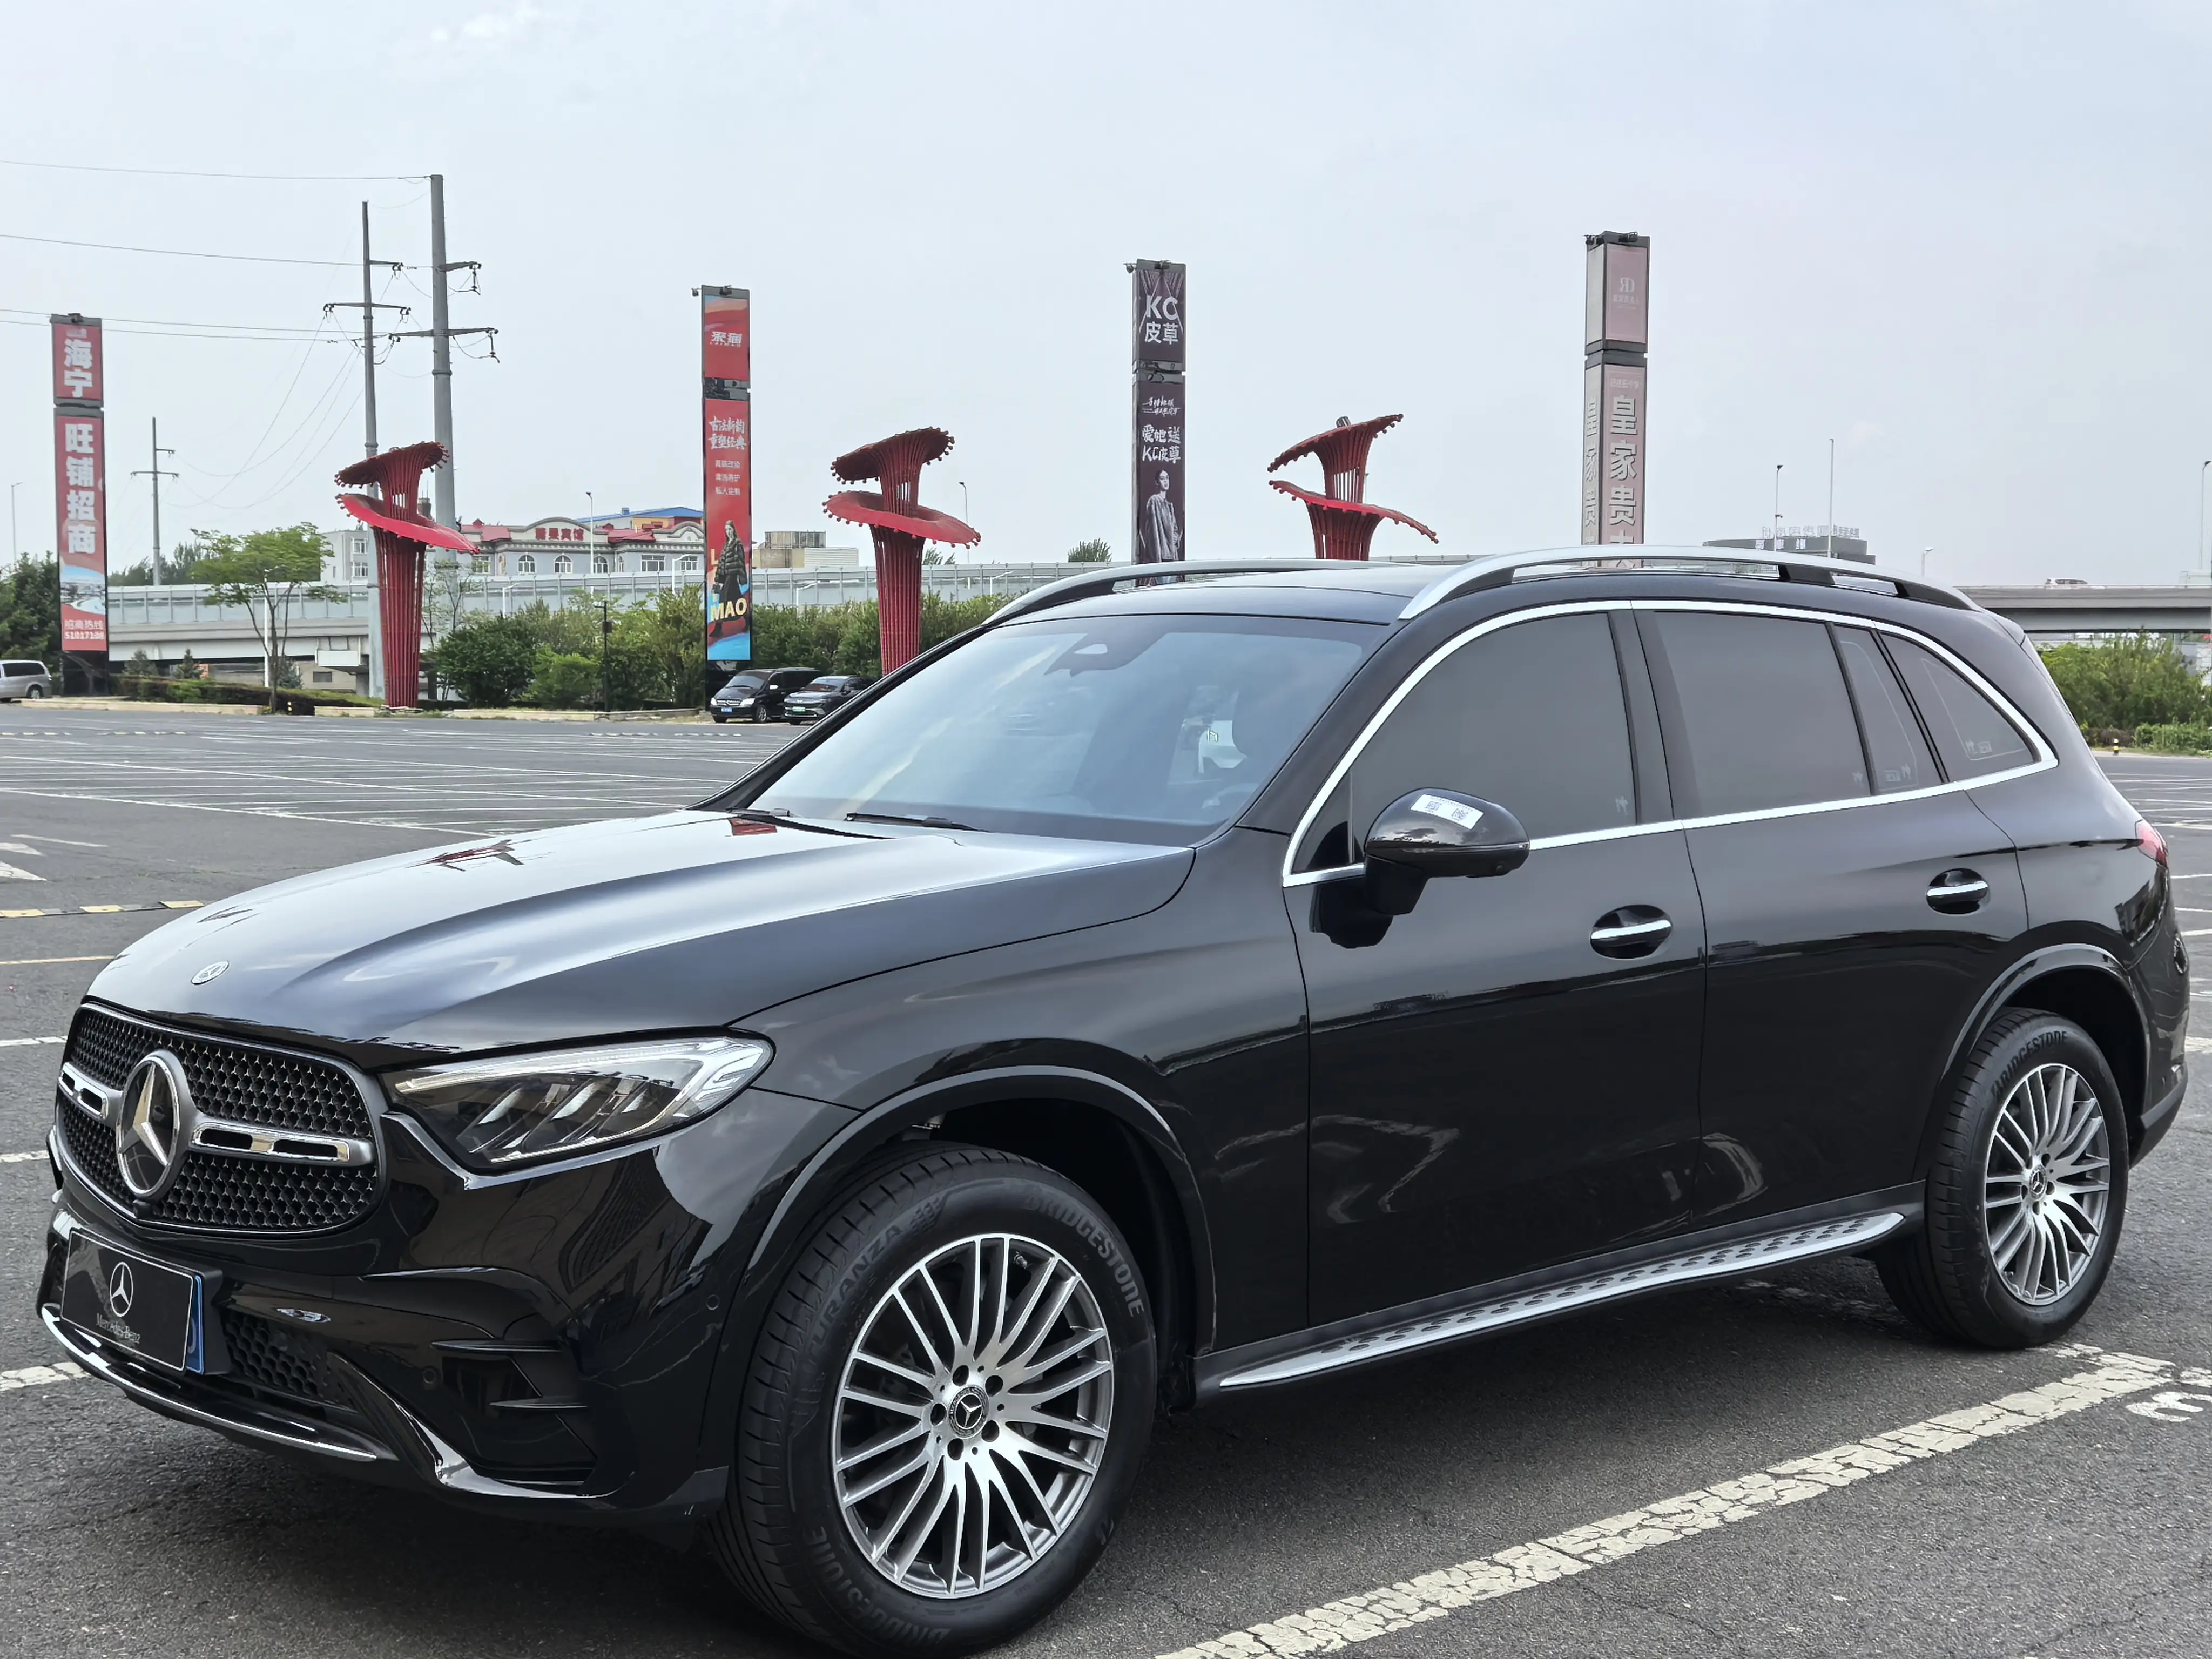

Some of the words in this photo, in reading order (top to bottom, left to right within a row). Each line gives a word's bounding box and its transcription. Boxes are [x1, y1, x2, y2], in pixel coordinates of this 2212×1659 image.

[1146, 295, 1178, 320] KC
[1144, 321, 1178, 345] 皮草
[63, 339, 93, 398] 海宁
[708, 433, 747, 450] 重塑经典
[1142, 445, 1181, 464] KC皮草
[65, 423, 96, 554] 旺铺招商
[710, 598, 747, 622] MAO
[1990, 1030, 2068, 1103] BRIDGESTONE
[1024, 1194, 1145, 1318] BRIDGESTONE
[802, 1525, 952, 1646] BRIDGESTONE
